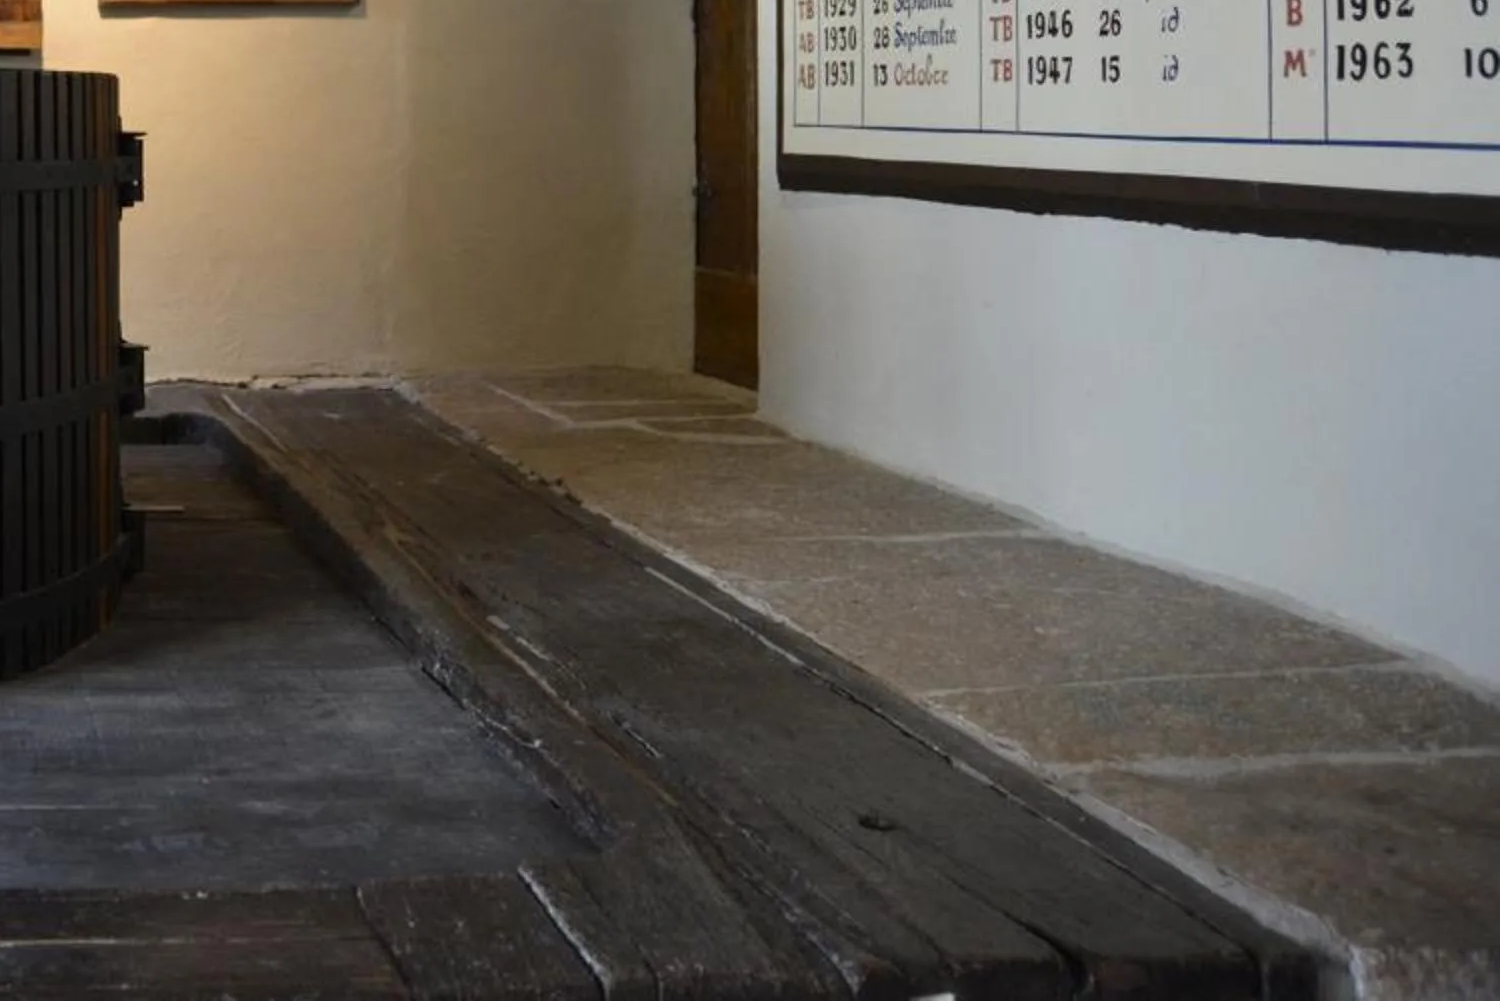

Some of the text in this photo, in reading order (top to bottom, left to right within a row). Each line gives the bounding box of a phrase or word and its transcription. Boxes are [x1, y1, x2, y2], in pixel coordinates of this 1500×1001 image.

[824, 25, 857, 51] 1930
[989, 6, 1180, 42] TB 1946 26 id
[825, 60, 855, 86] 1931
[873, 63, 888, 86] 13
[893, 52, 949, 86] Octobre
[990, 54, 1180, 86] TB 1947 15 id
[1336, 42, 1500, 82] 1963 10
